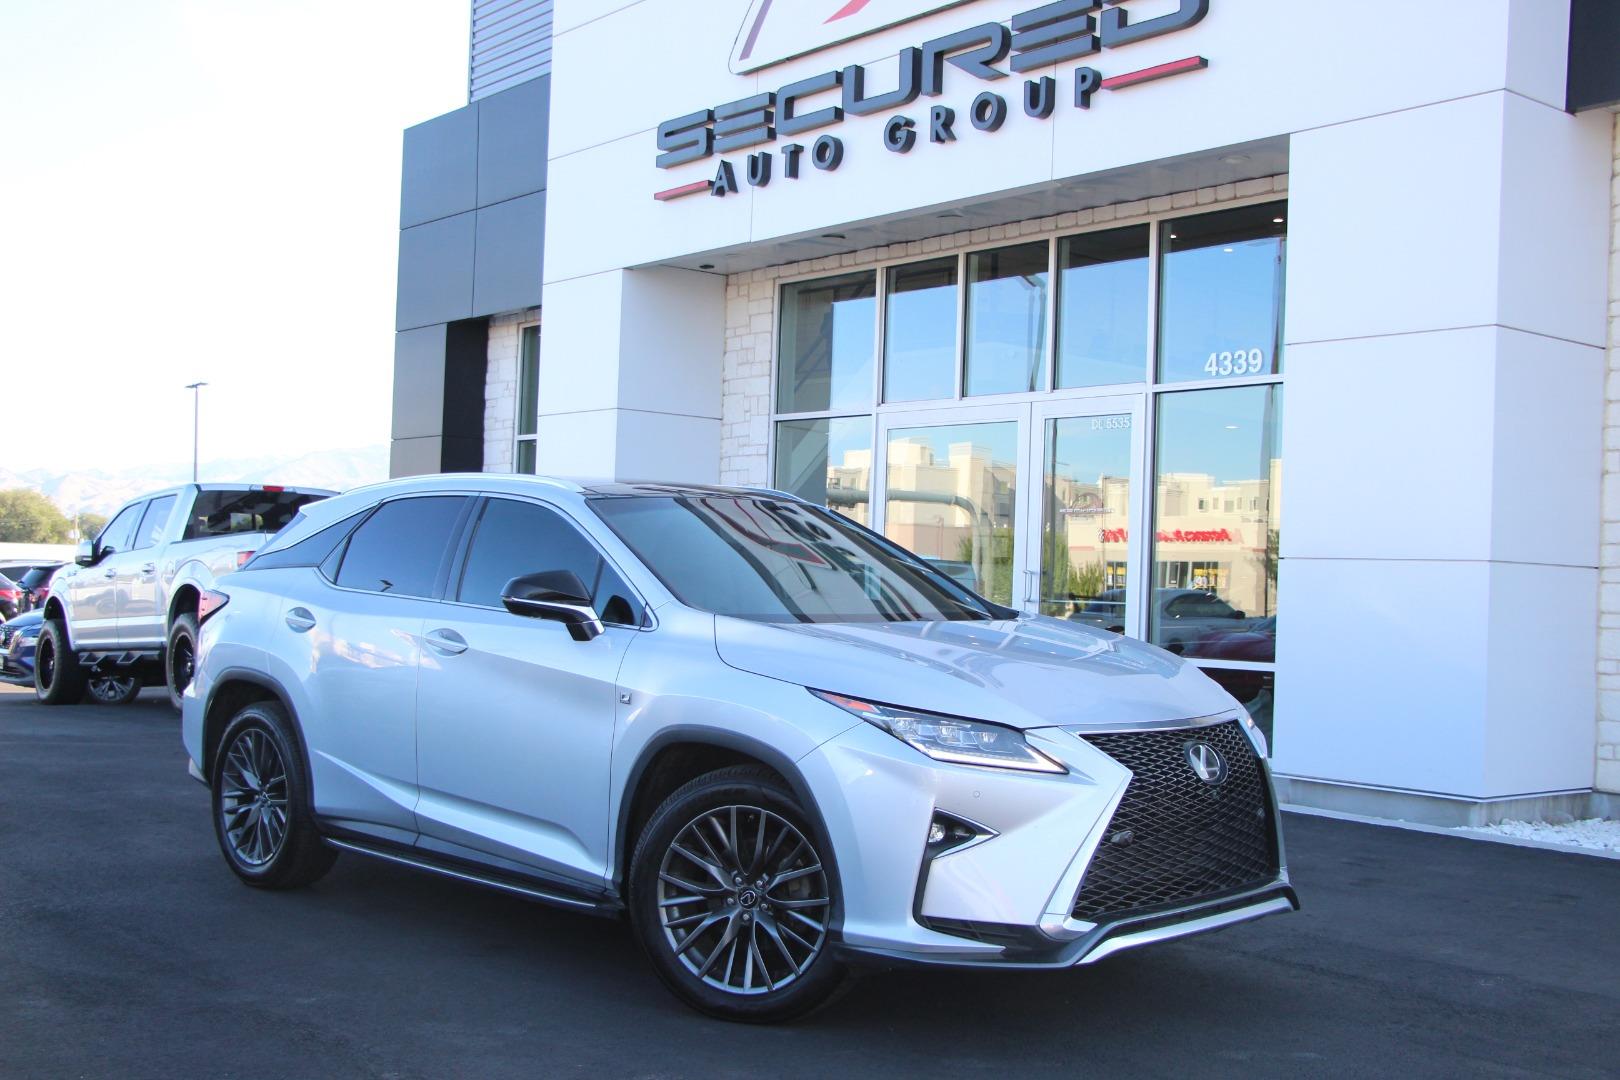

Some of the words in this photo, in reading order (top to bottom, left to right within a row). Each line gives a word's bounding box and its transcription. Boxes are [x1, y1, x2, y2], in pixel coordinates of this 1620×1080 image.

[656, 0, 1210, 169] SECURED
[711, 134, 844, 197] AUTO
[883, 66, 1102, 154] GROUP
[1204, 348, 1263, 376] 4339
